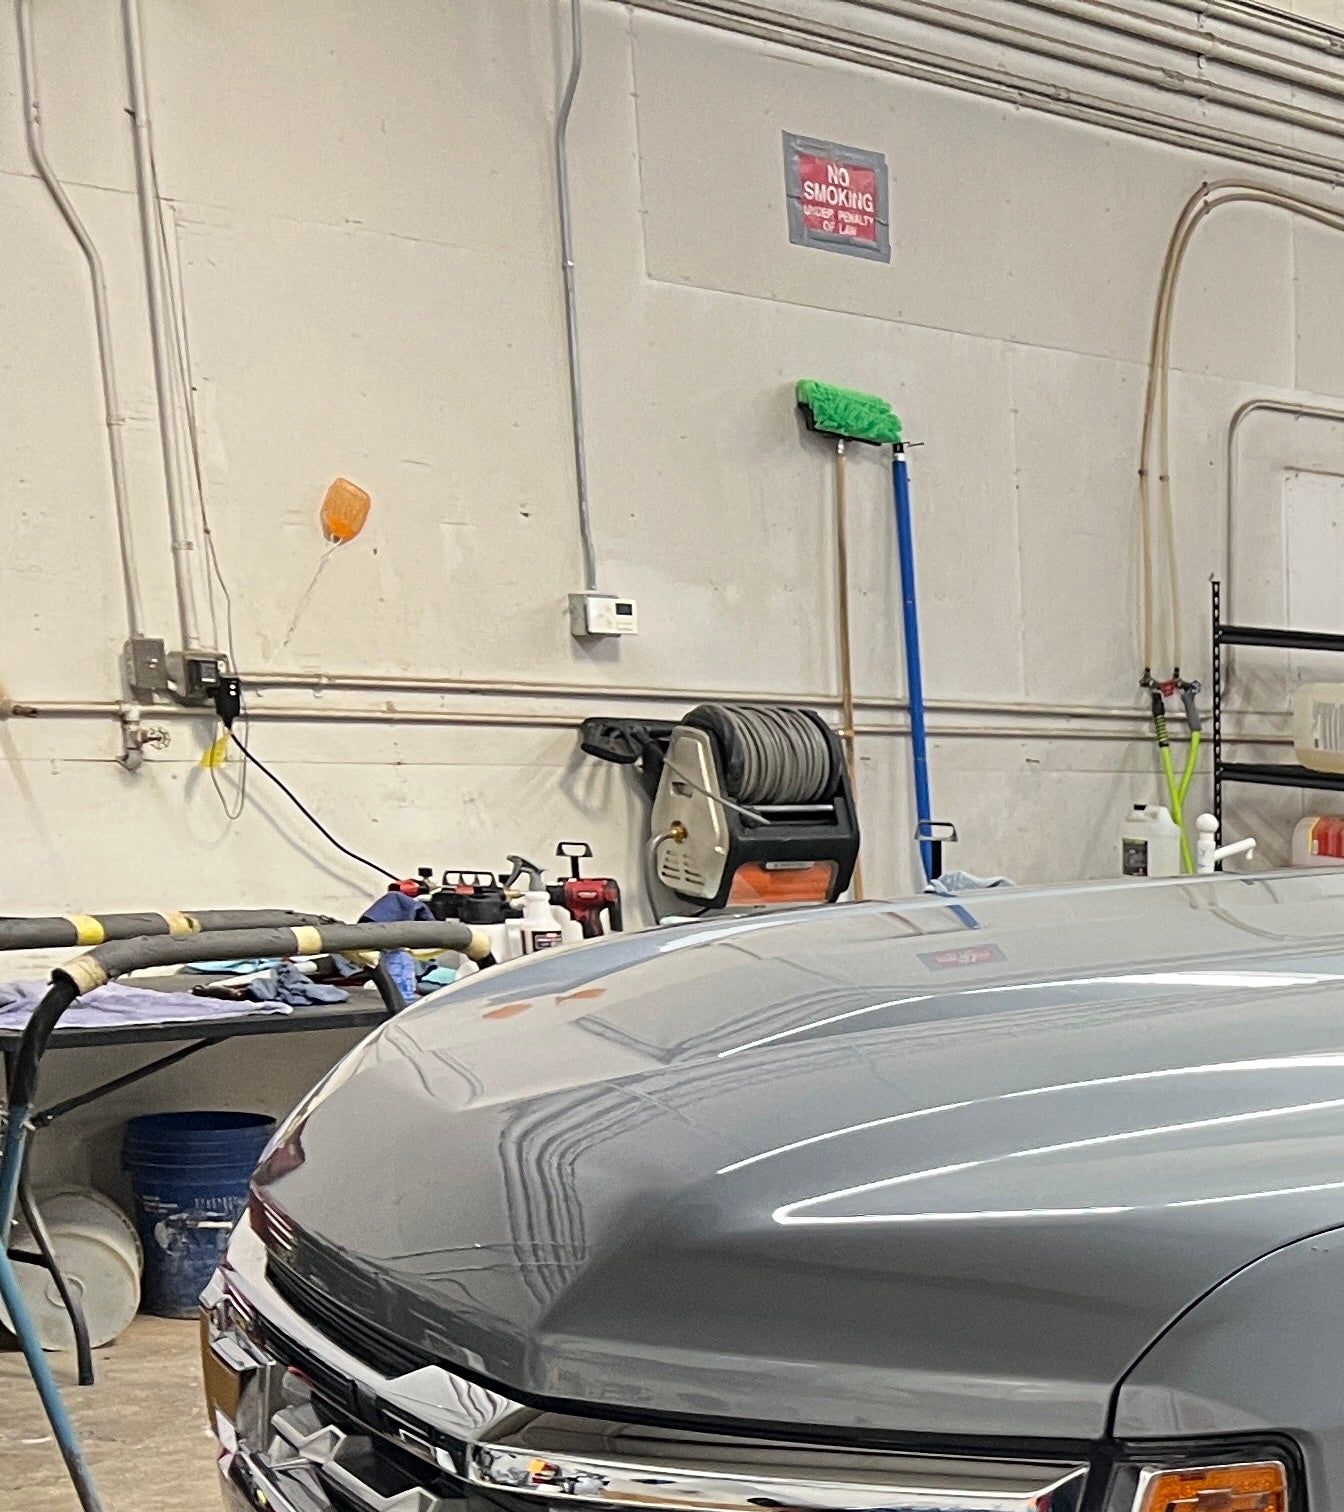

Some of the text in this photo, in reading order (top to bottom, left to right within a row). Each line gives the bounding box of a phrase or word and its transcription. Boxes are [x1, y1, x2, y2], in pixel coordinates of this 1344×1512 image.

[827, 164, 850, 187] NO
[803, 180, 874, 212] SMOKING
[822, 220, 858, 236] OF LAW
[837, 210, 875, 227] PENALTY
